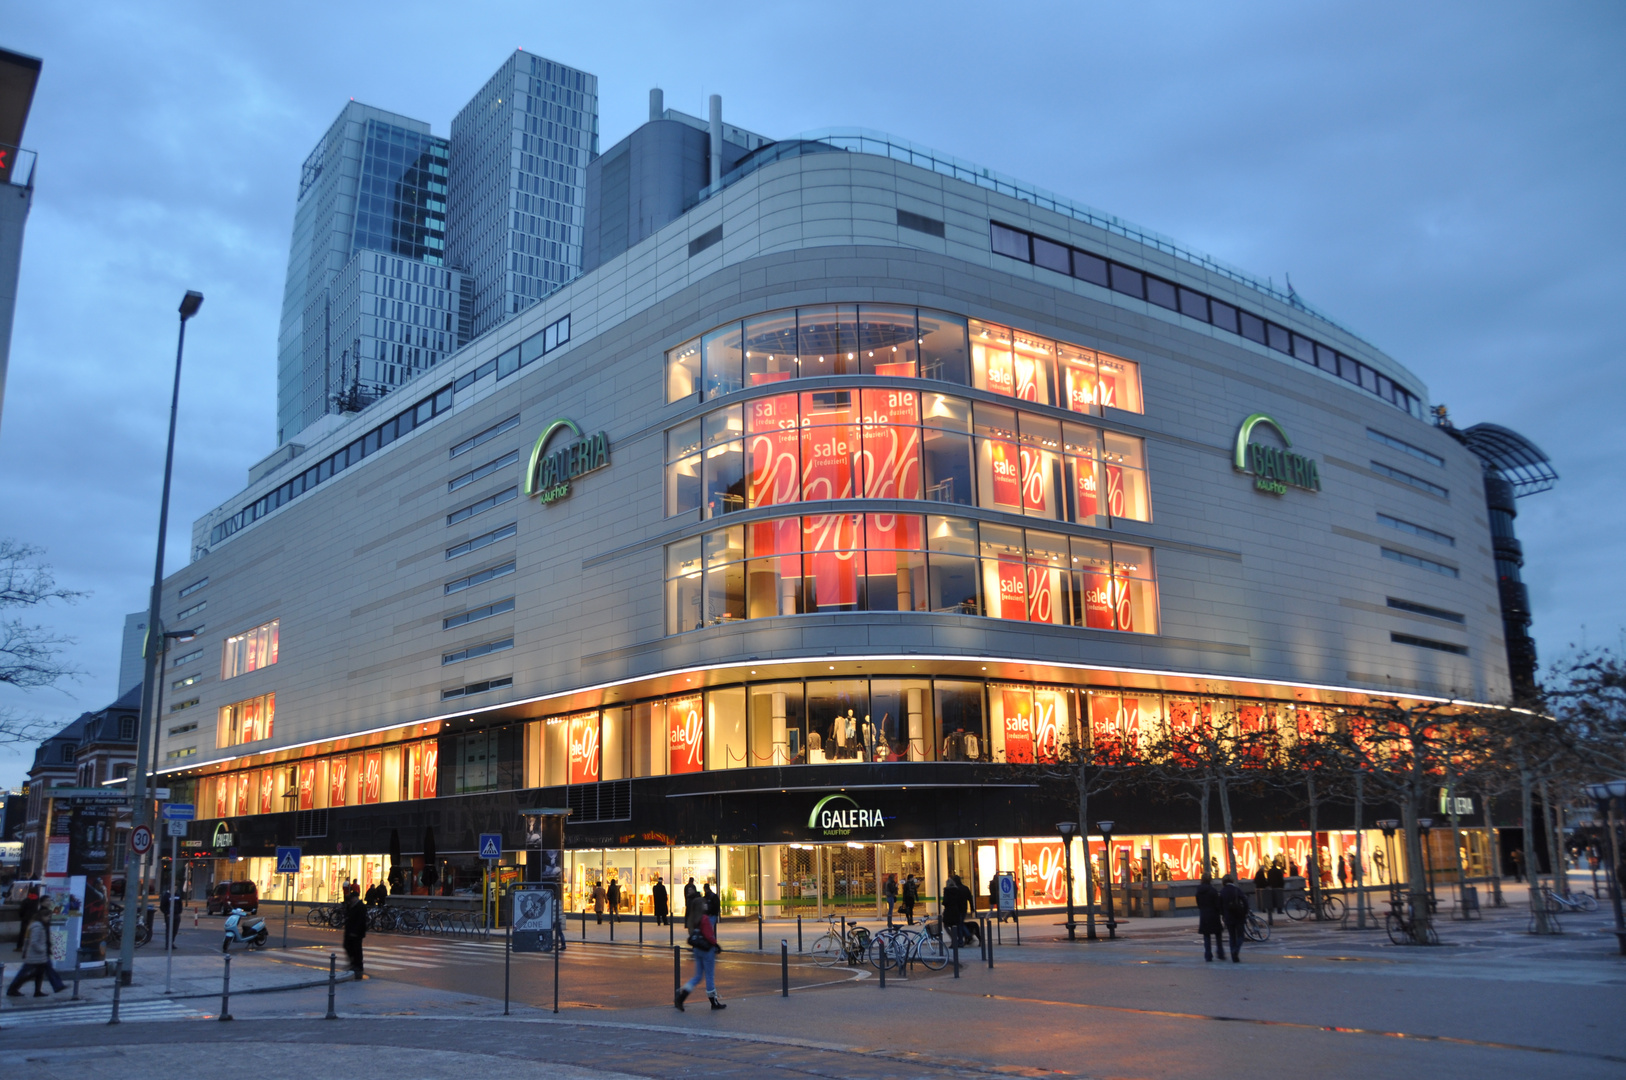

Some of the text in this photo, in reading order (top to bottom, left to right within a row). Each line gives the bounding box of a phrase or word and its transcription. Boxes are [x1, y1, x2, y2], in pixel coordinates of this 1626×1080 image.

[988, 368, 1010, 385] sale
[778, 415, 811, 434] sale
[855, 411, 888, 431] sale
[813, 438, 847, 458] sale
[540, 431, 608, 490] GALERIA
[814, 457, 848, 467] [reduziert]
[993, 459, 1016, 476] sale
[1252, 442, 1322, 492] GALERIA
[1001, 576, 1023, 594] sale
[1086, 587, 1107, 604] sale
[1006, 713, 1028, 731] sale
[1095, 717, 1115, 734] sale
[571, 740, 582, 755] ale
[821, 809, 885, 828] GALERIA
[135, 833, 149, 846] 30
[1023, 859, 1038, 876] ale
[523, 921, 543, 929] ZONE
